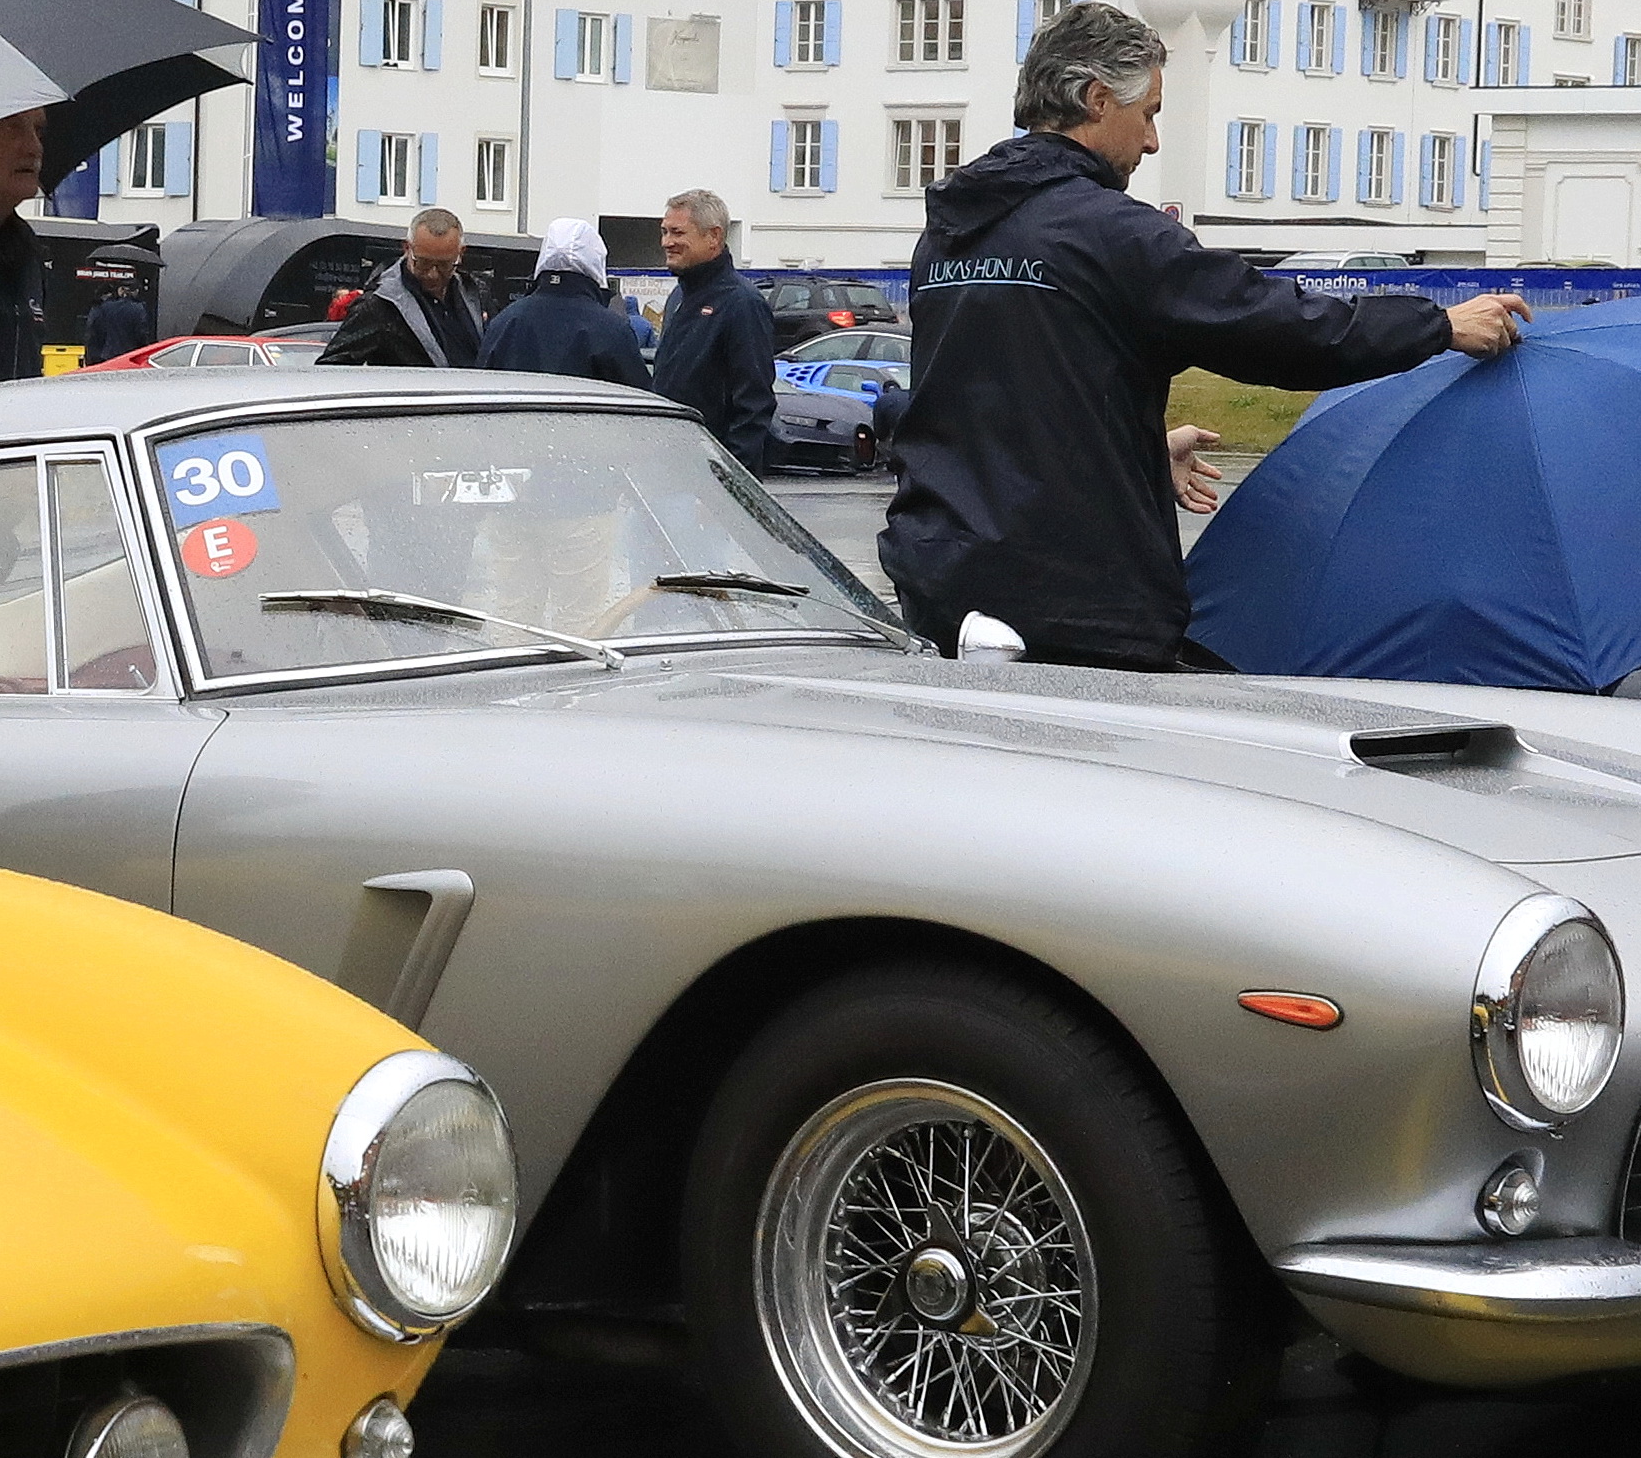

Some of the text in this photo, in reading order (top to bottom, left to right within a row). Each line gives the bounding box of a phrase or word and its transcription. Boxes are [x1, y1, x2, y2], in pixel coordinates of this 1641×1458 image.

[928, 260, 971, 283] LUKAS
[1017, 258, 1044, 282] AG
[1296, 275, 1367, 292] Engadina
[173, 450, 265, 506] 30
[202, 525, 234, 559] E
